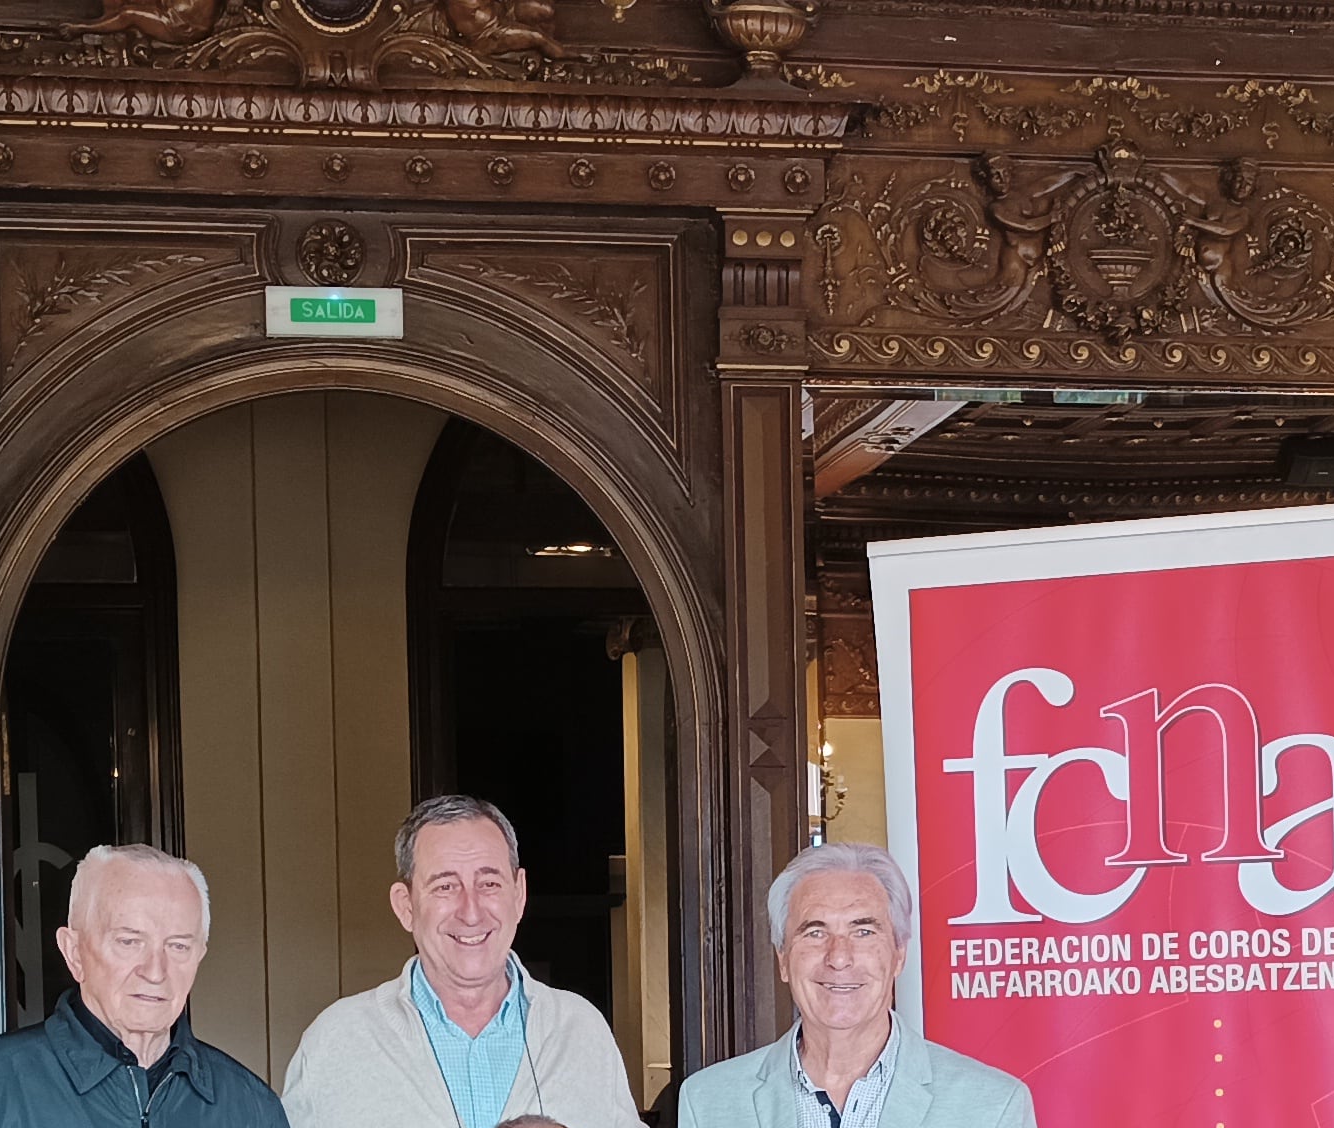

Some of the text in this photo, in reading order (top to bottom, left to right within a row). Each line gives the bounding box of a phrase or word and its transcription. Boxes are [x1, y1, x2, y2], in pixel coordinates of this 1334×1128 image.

[302, 301, 365, 319] SALIDA
[950, 933, 1131, 967] FEDERACION
[1142, 932, 1180, 961] DE
[1189, 928, 1291, 960] COROS
[951, 966, 1141, 1000] NAFARROAKO
